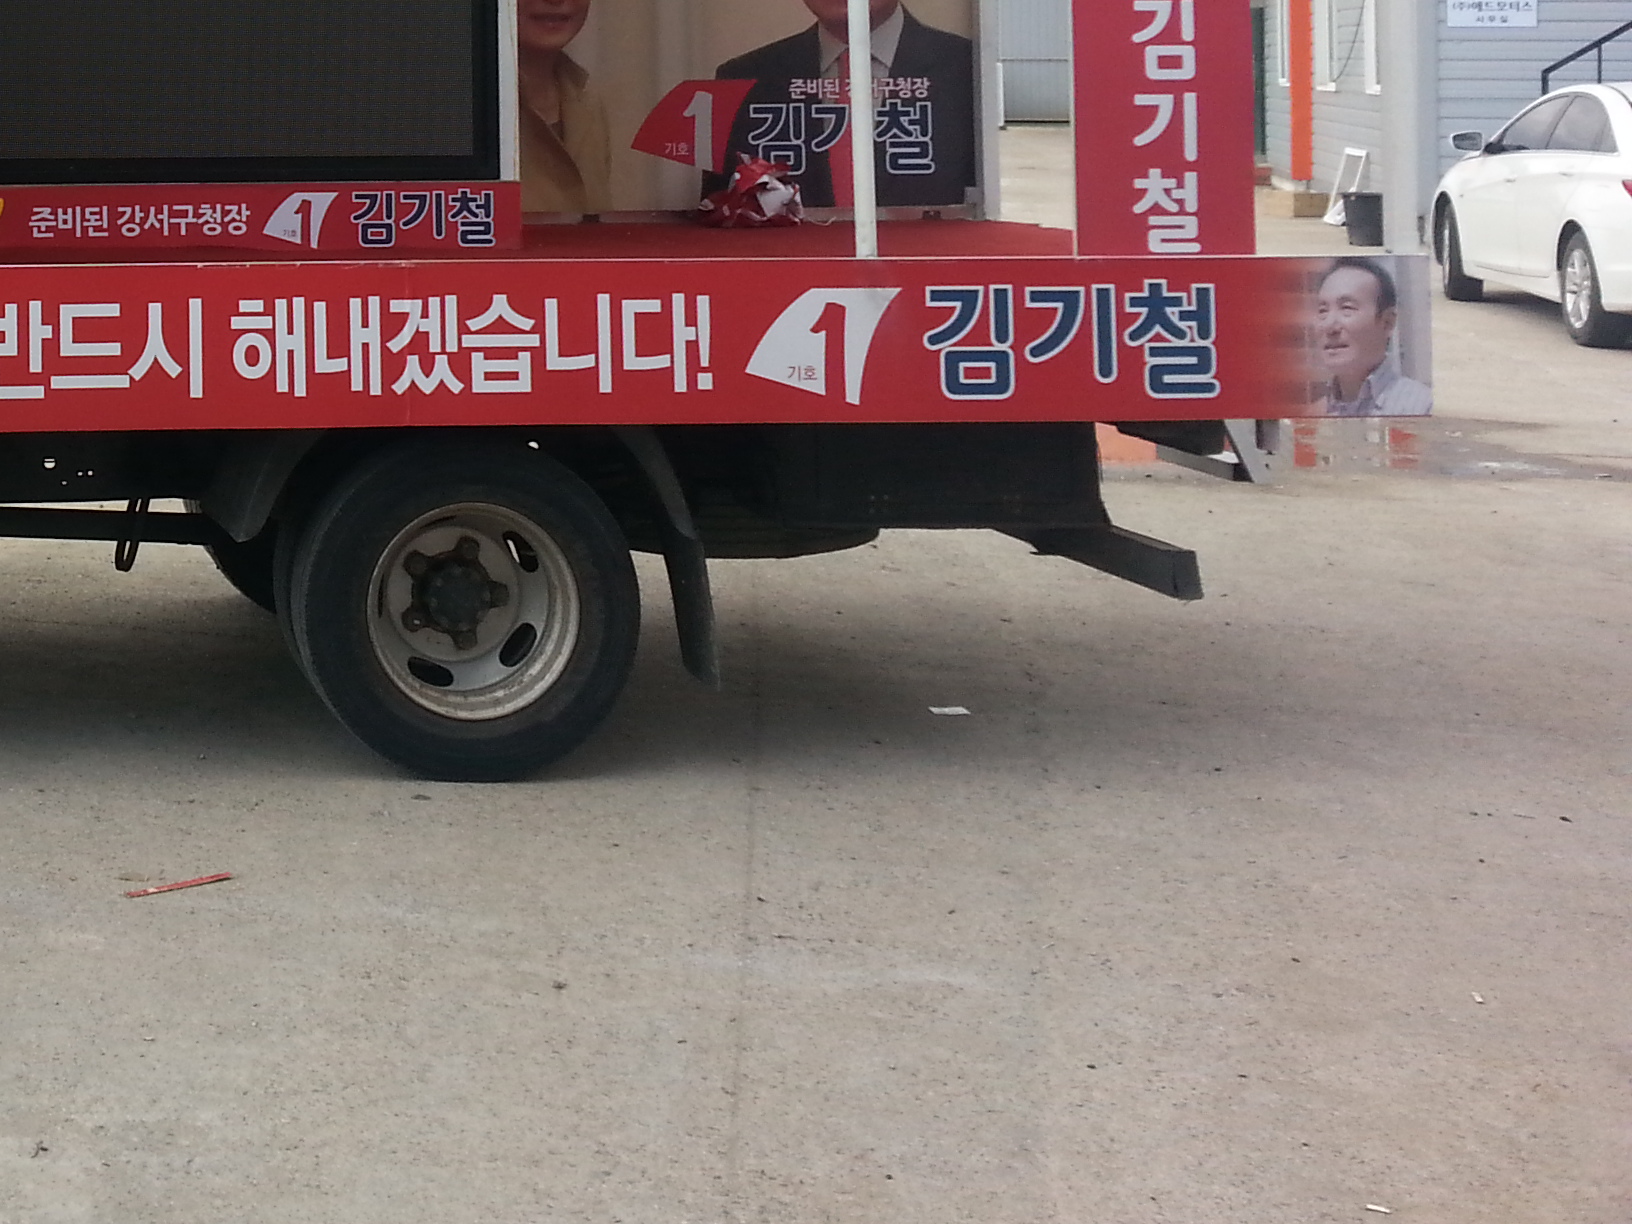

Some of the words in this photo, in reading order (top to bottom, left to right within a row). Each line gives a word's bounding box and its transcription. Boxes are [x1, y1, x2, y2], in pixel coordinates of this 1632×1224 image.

[789, 79, 840, 99] 준비된
[664, 142, 689, 156] 기호
[29, 206, 109, 238] 준비된
[116, 204, 251, 237] 강서구청장
[351, 188, 496, 247] 김기철
[230, 293, 713, 397] 해내겠습니다!
[923, 279, 1221, 400] 김기철
[786, 364, 818, 382] 기호
